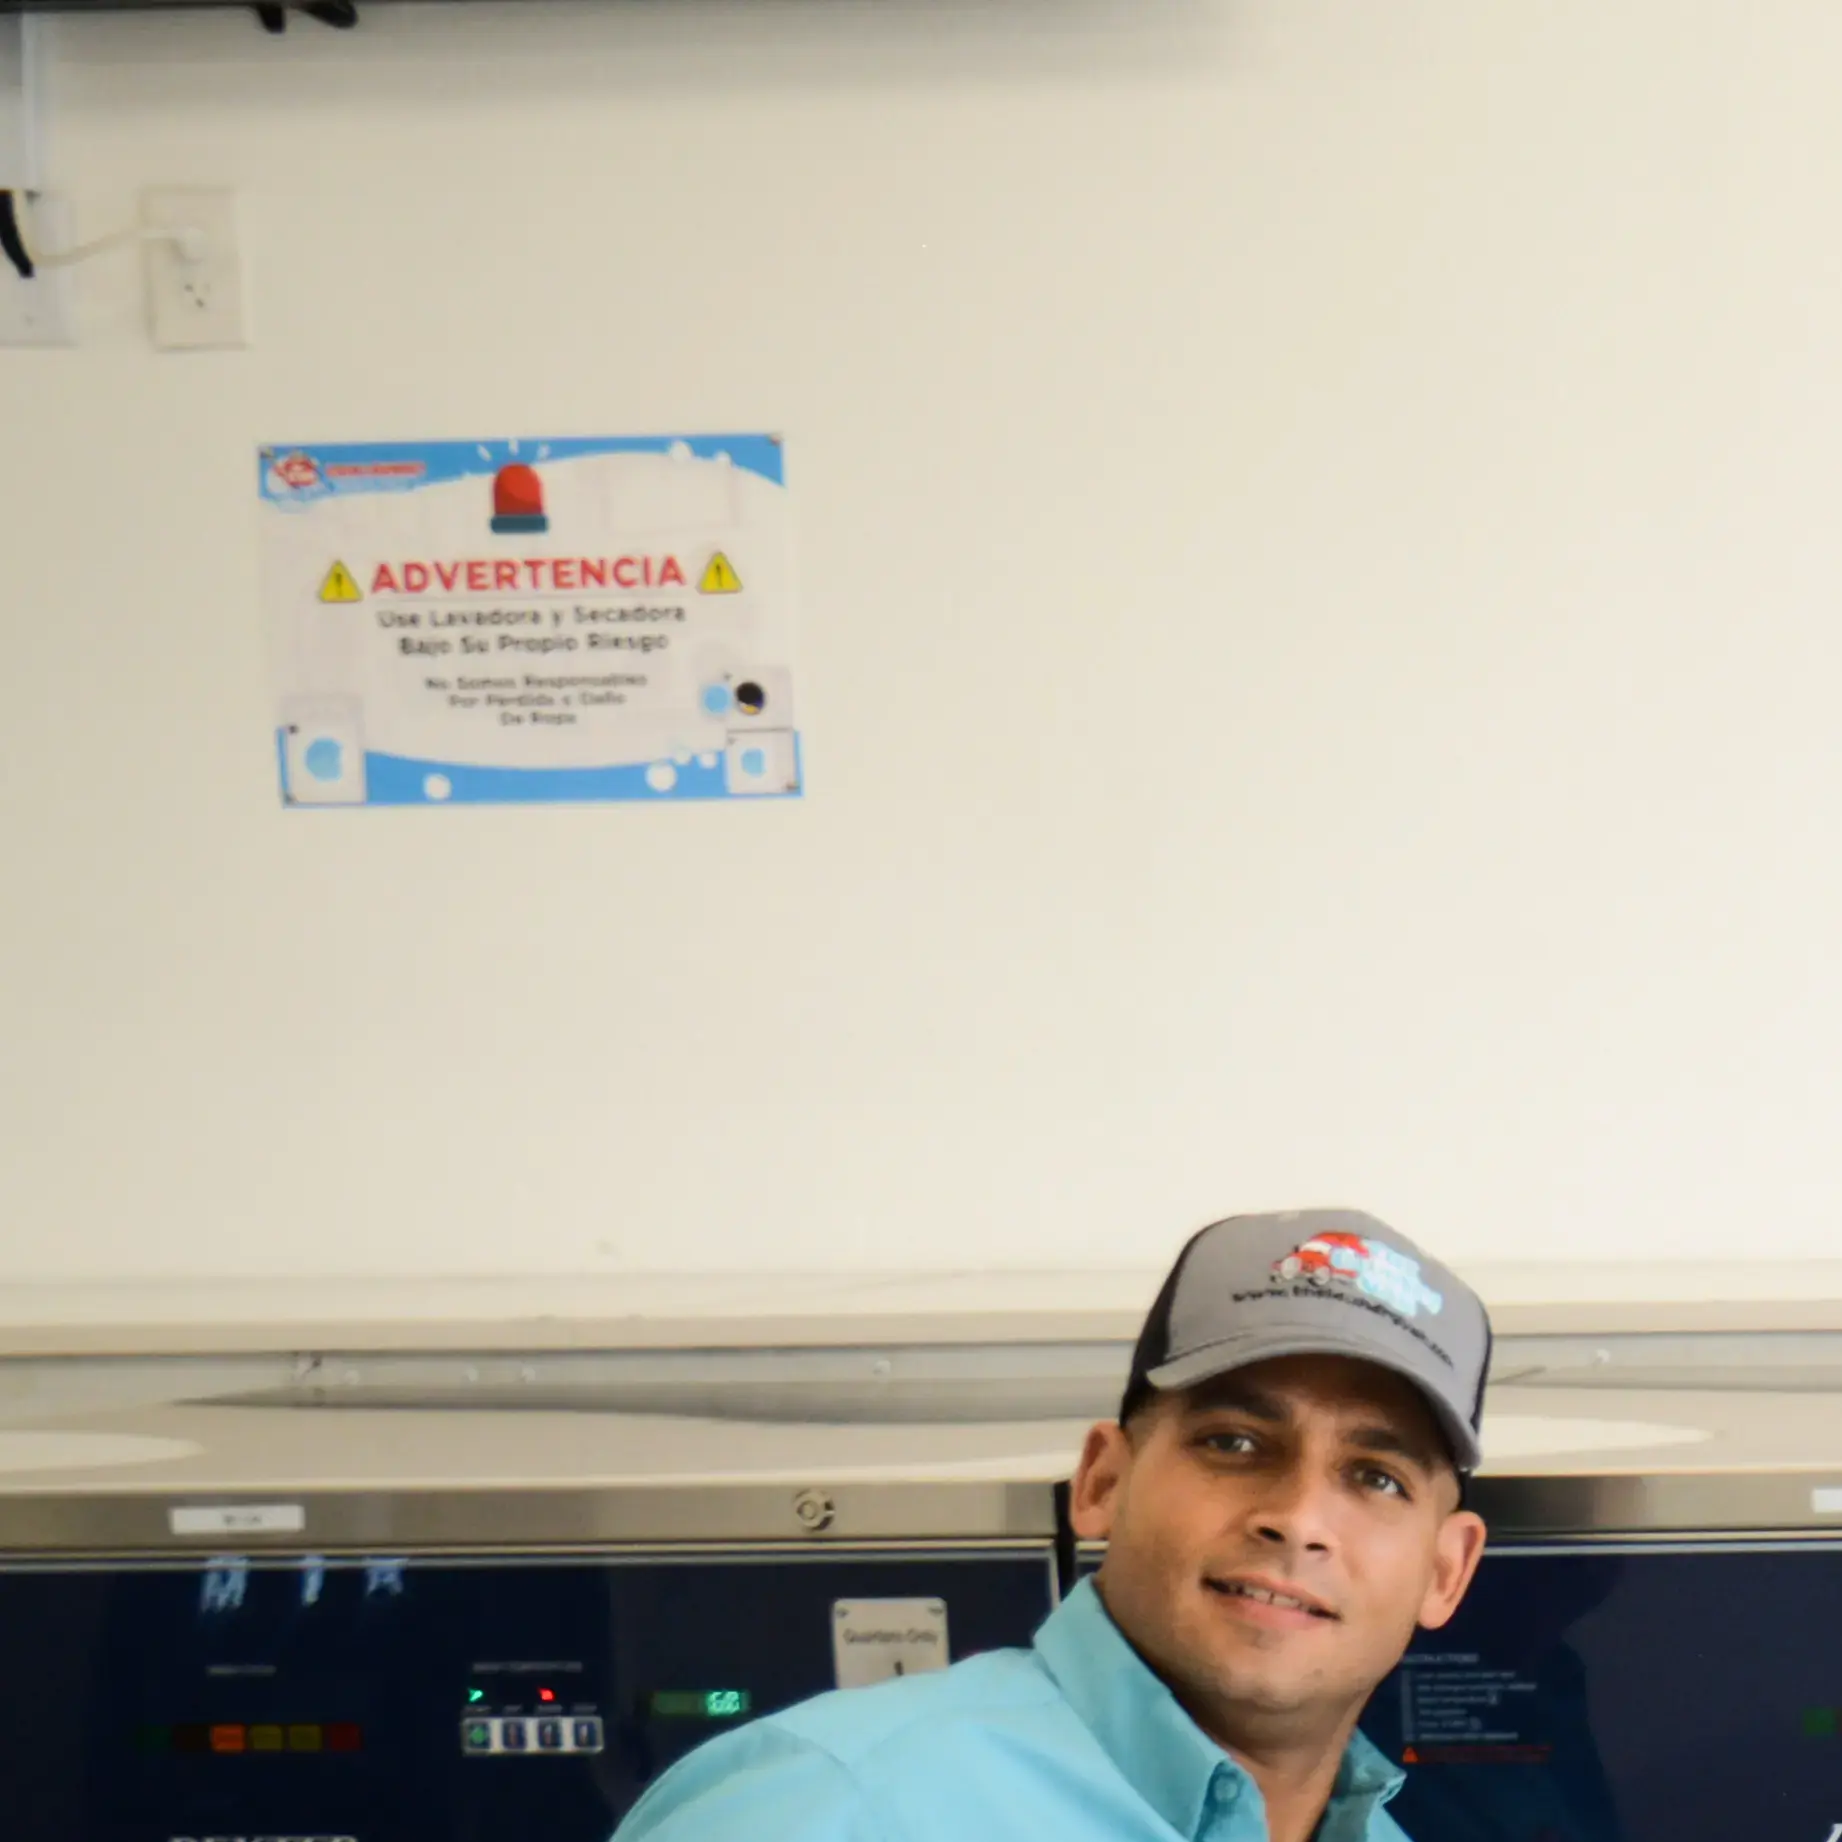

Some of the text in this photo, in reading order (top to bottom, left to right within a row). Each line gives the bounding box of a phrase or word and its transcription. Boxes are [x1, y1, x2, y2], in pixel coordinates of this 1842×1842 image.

[371, 556, 686, 594] ADVERTENCIA
[376, 609, 420, 628] Use
[429, 608, 543, 628] Lavadora
[573, 604, 686, 624] Secadora
